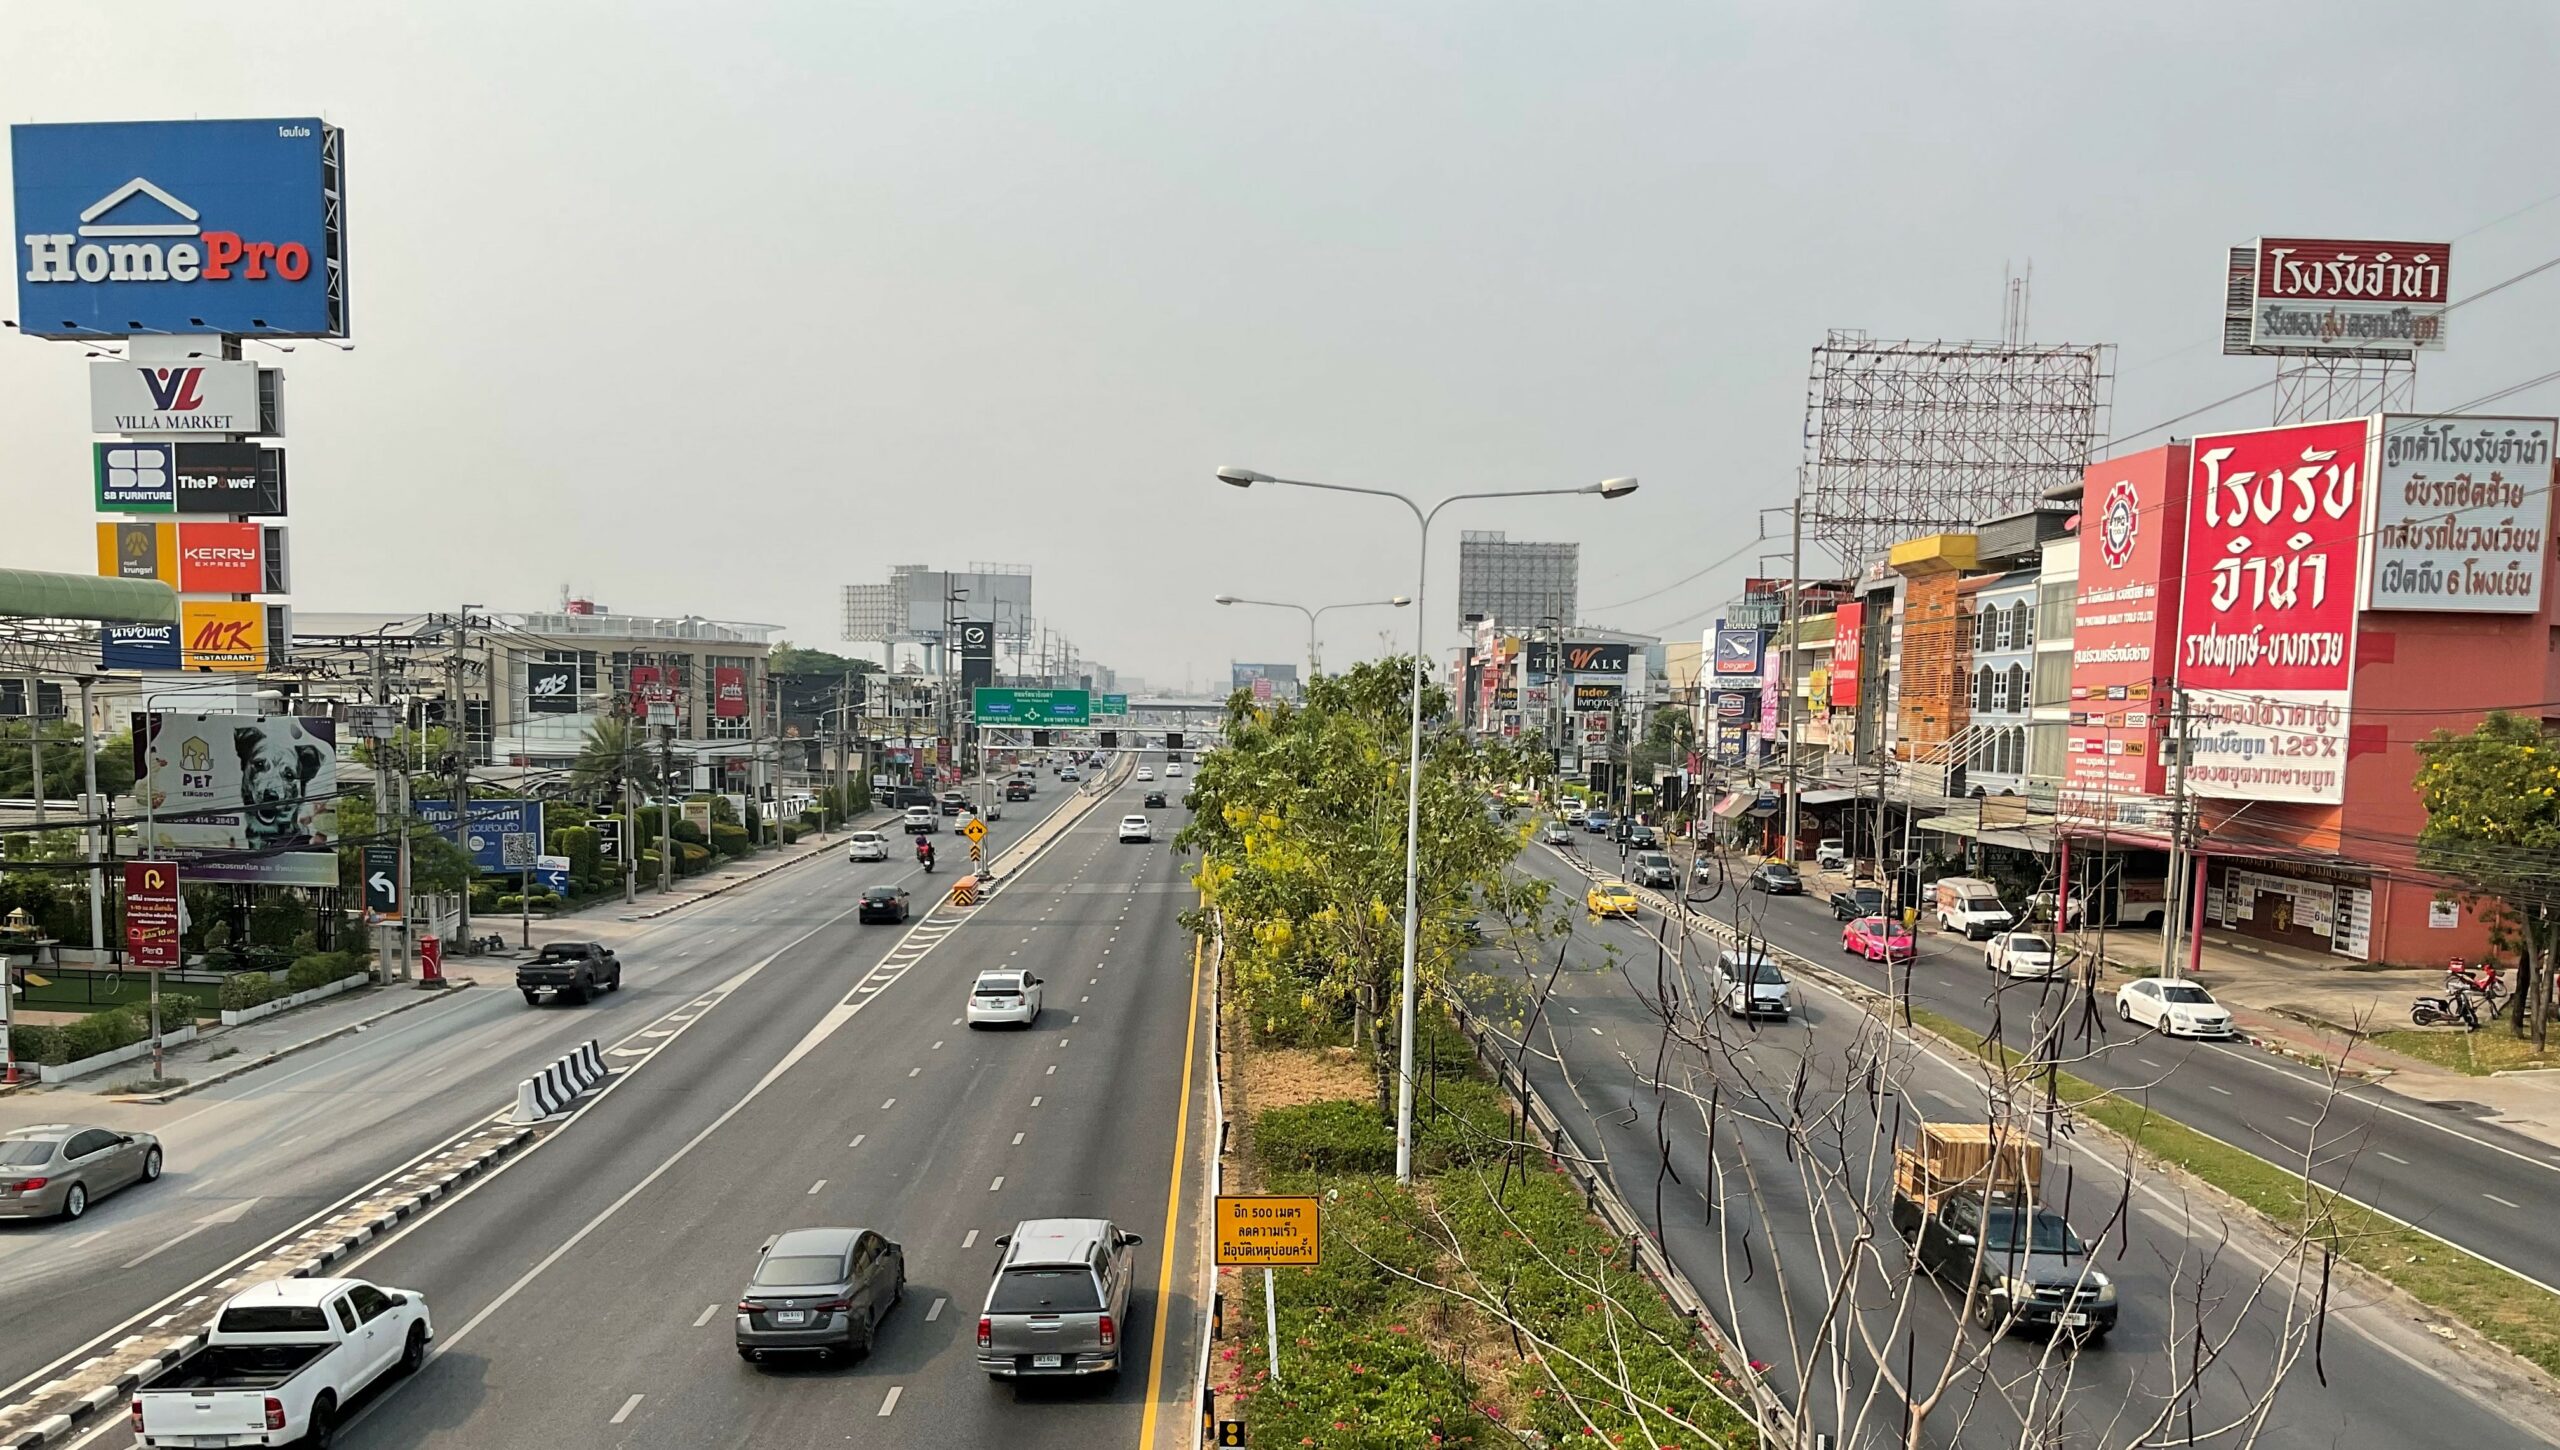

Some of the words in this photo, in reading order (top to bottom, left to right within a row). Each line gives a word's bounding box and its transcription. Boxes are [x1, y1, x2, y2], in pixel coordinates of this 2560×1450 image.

[278, 125, 310, 138] โฮมโปร
[25, 231, 310, 282] HomePro
[2269, 248, 2440, 298] โรงรับจำนำ
[115, 415, 160, 429] VILLA
[166, 415, 233, 429] MARKET
[2388, 424, 2548, 467] ลูกค้าโรงรับจำนำ
[104, 491, 117, 500] SB
[119, 491, 172, 500] FURNITURE
[2200, 445, 2357, 528] โรงรับ
[2404, 470, 2525, 508] ขับรถชิดซ้าย
[2382, 512, 2541, 553] กลับรถในวงเวียน
[185, 548, 256, 560] KERRY
[123, 567, 153, 575] krungsri
[2211, 532, 2328, 613] จำนำ
[2382, 559, 2443, 593] เปิดถึง
[2447, 569, 2460, 594] 6
[2463, 557, 2533, 596] โมงเย็น
[193, 620, 254, 652] MK
[1835, 623, 1859, 662] คั่วไก่
[194, 653, 256, 662] RESTAURANTS
[1570, 647, 1621, 669] WALK
[2186, 621, 2344, 676] ราชพฤกษ์-บางกรวย
[1578, 687, 1609, 697] Index
[2194, 729, 2265, 760] อกเบี้ยถูก
[183, 773, 214, 788] PET
[183, 790, 214, 798] KINGDOM
[1234, 1203, 1247, 1218] อีก
[1252, 1208, 1272, 1218] 500
[1275, 1208, 1301, 1218] เมตร
[1239, 1221, 1298, 1237] ลดความเร็ว
[1223, 1238, 1312, 1261] มีอุบัติเหตุบ่อยครั้ง
